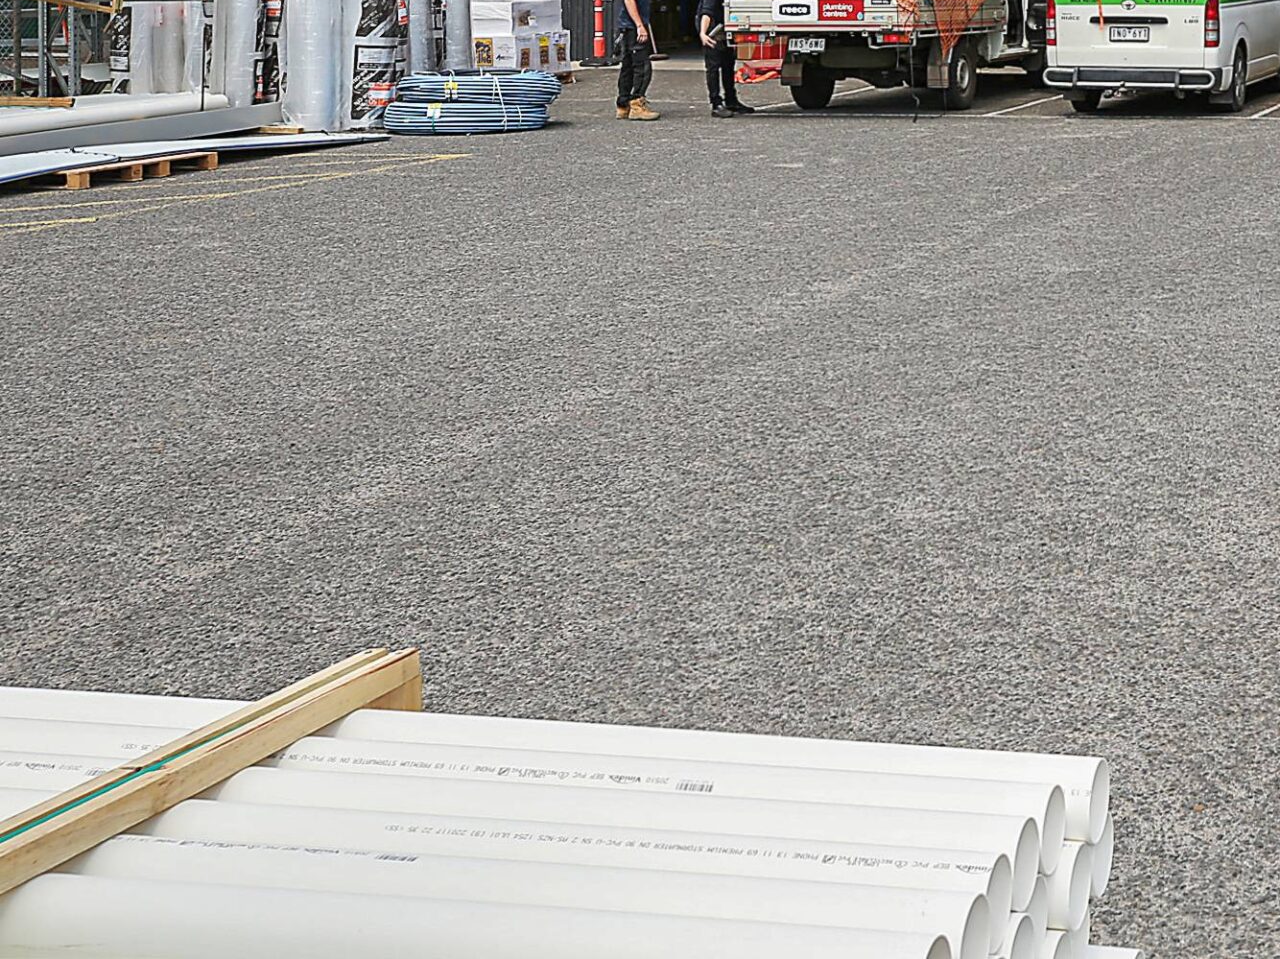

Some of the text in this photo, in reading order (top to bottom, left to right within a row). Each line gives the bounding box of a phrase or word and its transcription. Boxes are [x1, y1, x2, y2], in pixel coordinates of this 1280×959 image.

[781, 6, 808, 14] reece
[822, 3, 853, 12] plumbing
[608, 774, 641, 784] Vinidex
[706, 846, 743, 855] PREMIUM
